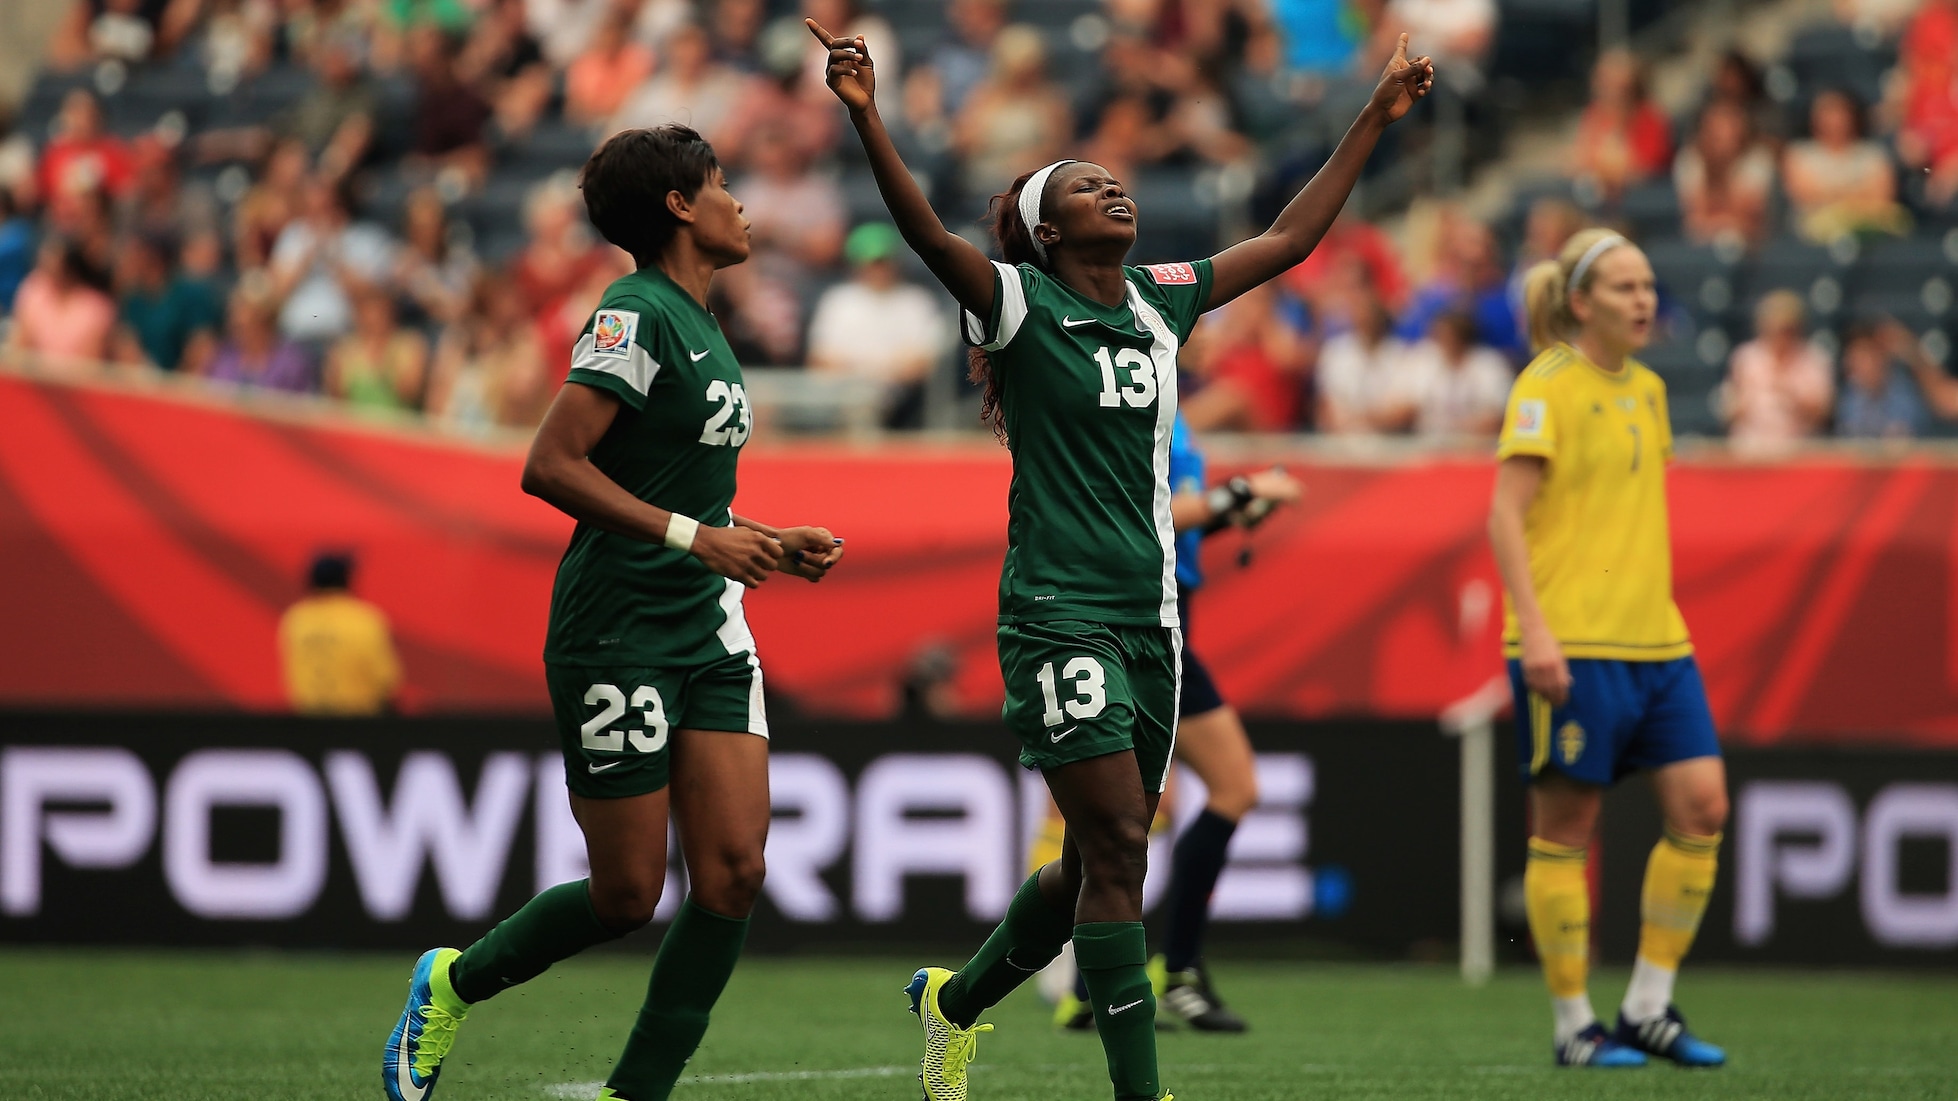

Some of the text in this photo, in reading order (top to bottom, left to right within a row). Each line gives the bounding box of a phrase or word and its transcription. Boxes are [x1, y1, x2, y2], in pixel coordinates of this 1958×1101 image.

[1093, 346, 1157, 408] 13
[698, 379, 752, 447] 23
[581, 683, 669, 753] 23
[1036, 656, 1107, 728] 13
[1734, 779, 1958, 947] PO
